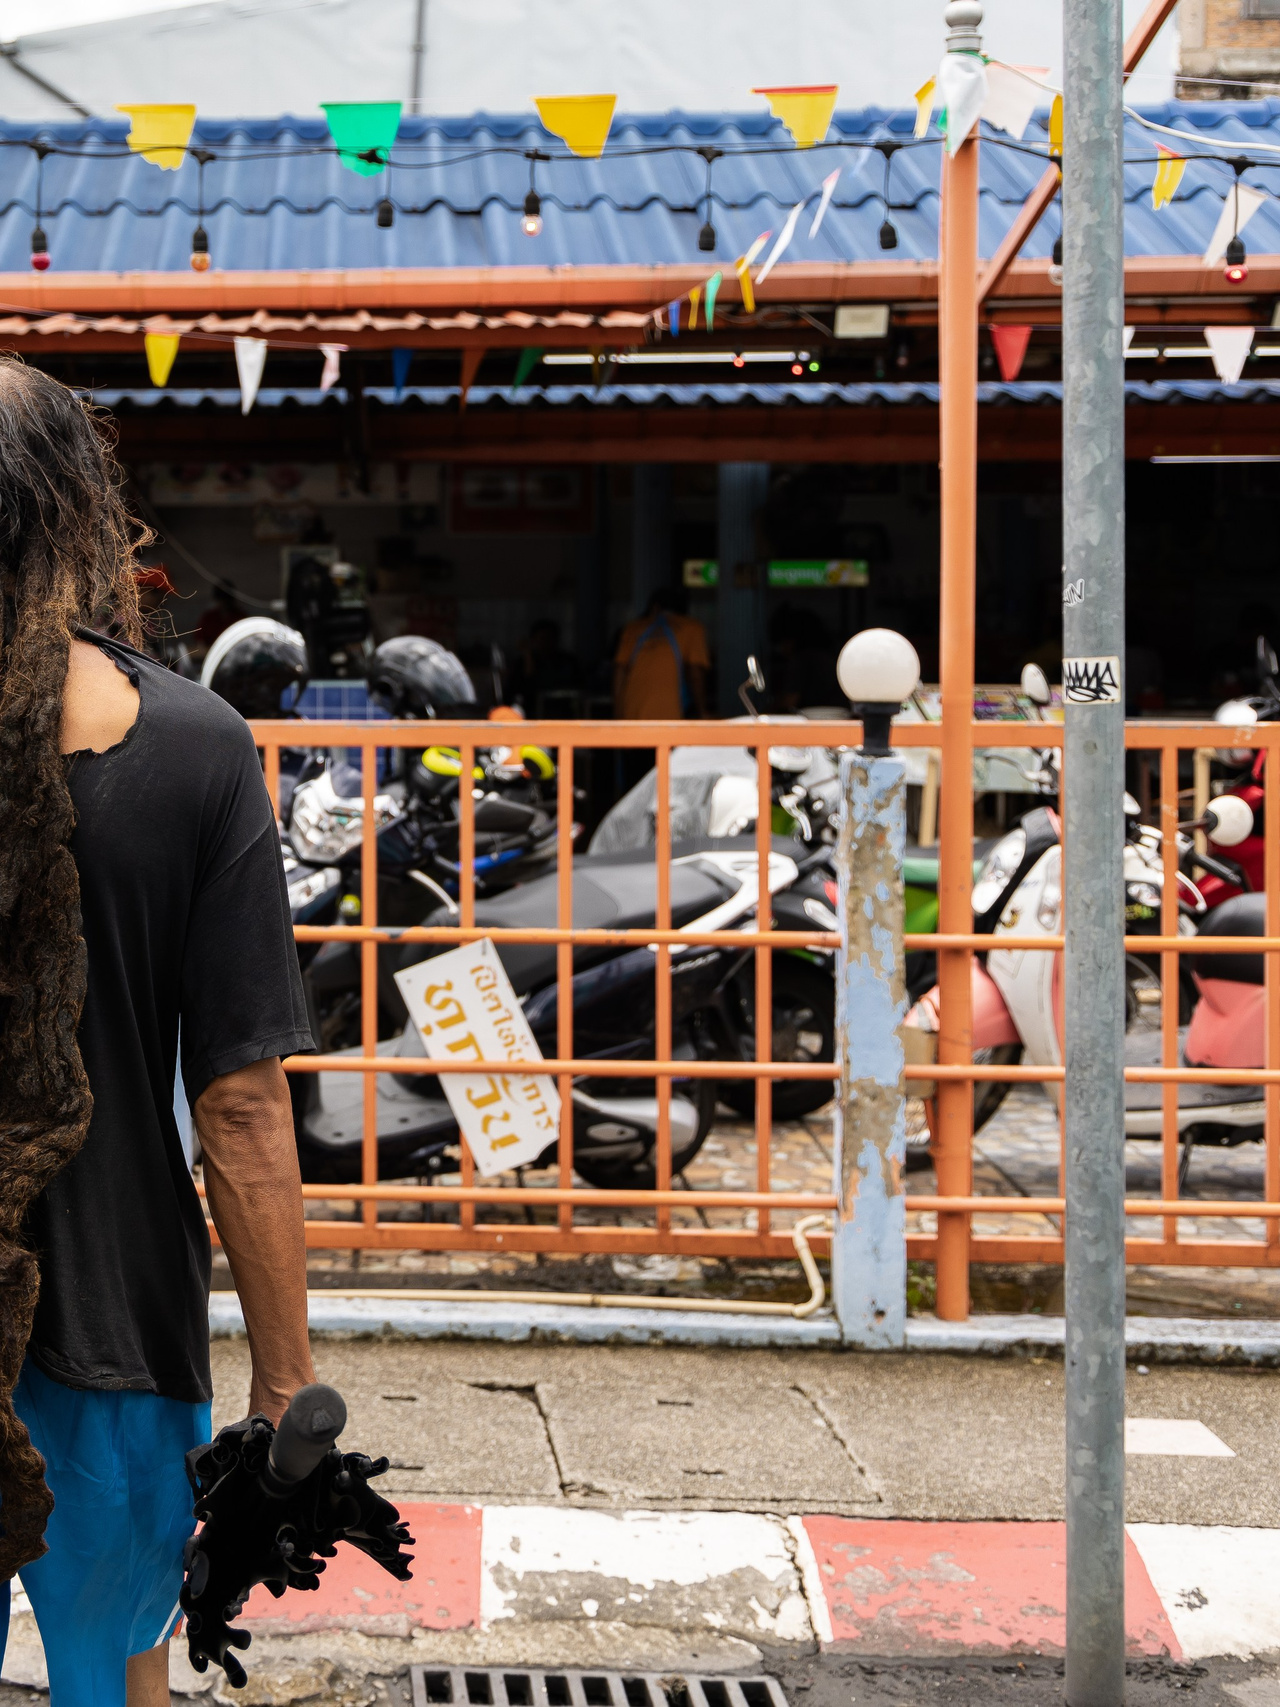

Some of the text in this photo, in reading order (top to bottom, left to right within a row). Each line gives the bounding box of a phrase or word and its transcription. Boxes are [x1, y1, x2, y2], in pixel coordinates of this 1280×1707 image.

[470, 965, 556, 1131] เปิดให้บการ
